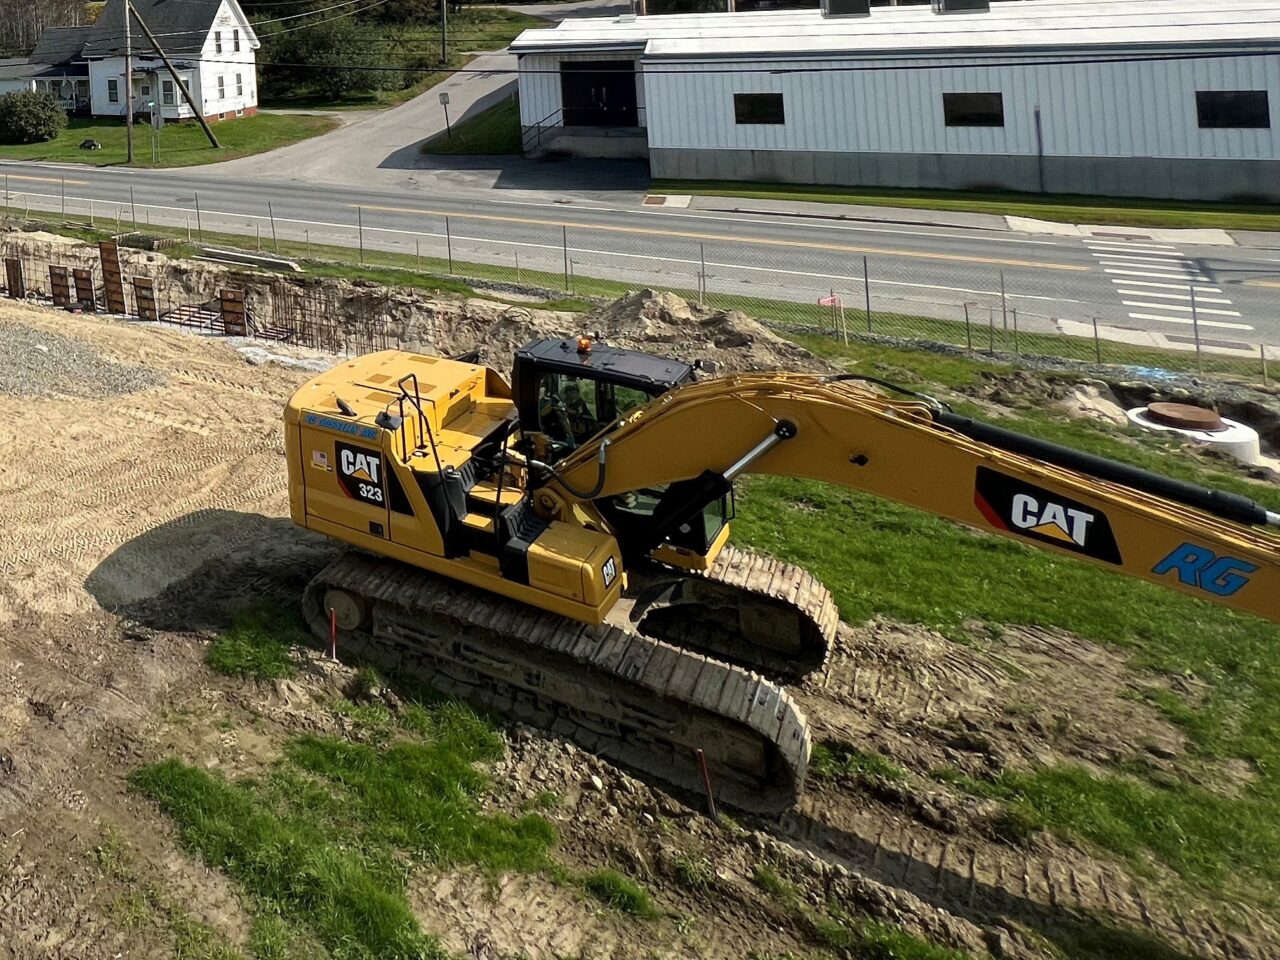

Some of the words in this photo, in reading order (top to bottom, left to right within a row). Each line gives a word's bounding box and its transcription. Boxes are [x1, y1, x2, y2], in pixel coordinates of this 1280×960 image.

[341, 449, 380, 483] CAT
[358, 483, 383, 501] 323
[1011, 493, 1094, 547] CAT
[603, 558, 615, 586] CAT
[1152, 542, 1261, 597] RG
